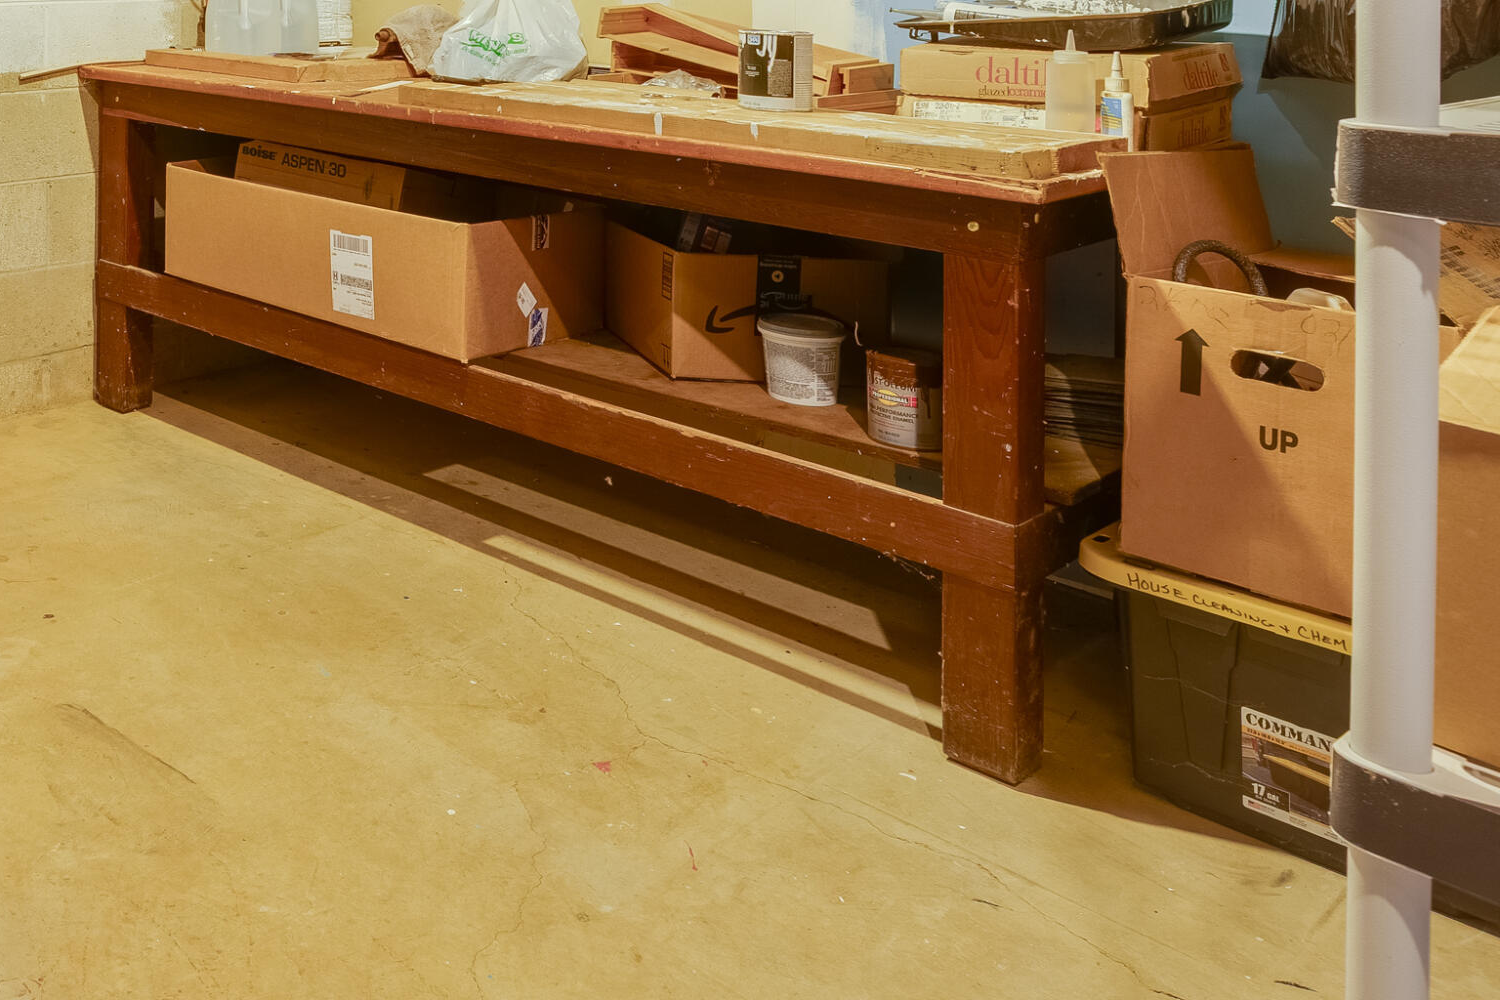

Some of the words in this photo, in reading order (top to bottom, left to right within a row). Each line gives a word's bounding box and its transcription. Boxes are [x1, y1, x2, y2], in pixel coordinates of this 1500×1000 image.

[281, 153, 325, 174] ASPEN
[1259, 425, 1299, 454] UP
[1126, 572, 1187, 600] HOUSE
[1192, 593, 1275, 628] CLEANING
[1296, 625, 1349, 652] CHEM
[1245, 712, 1332, 753] COMMAN
[1251, 782, 1266, 797] 17
